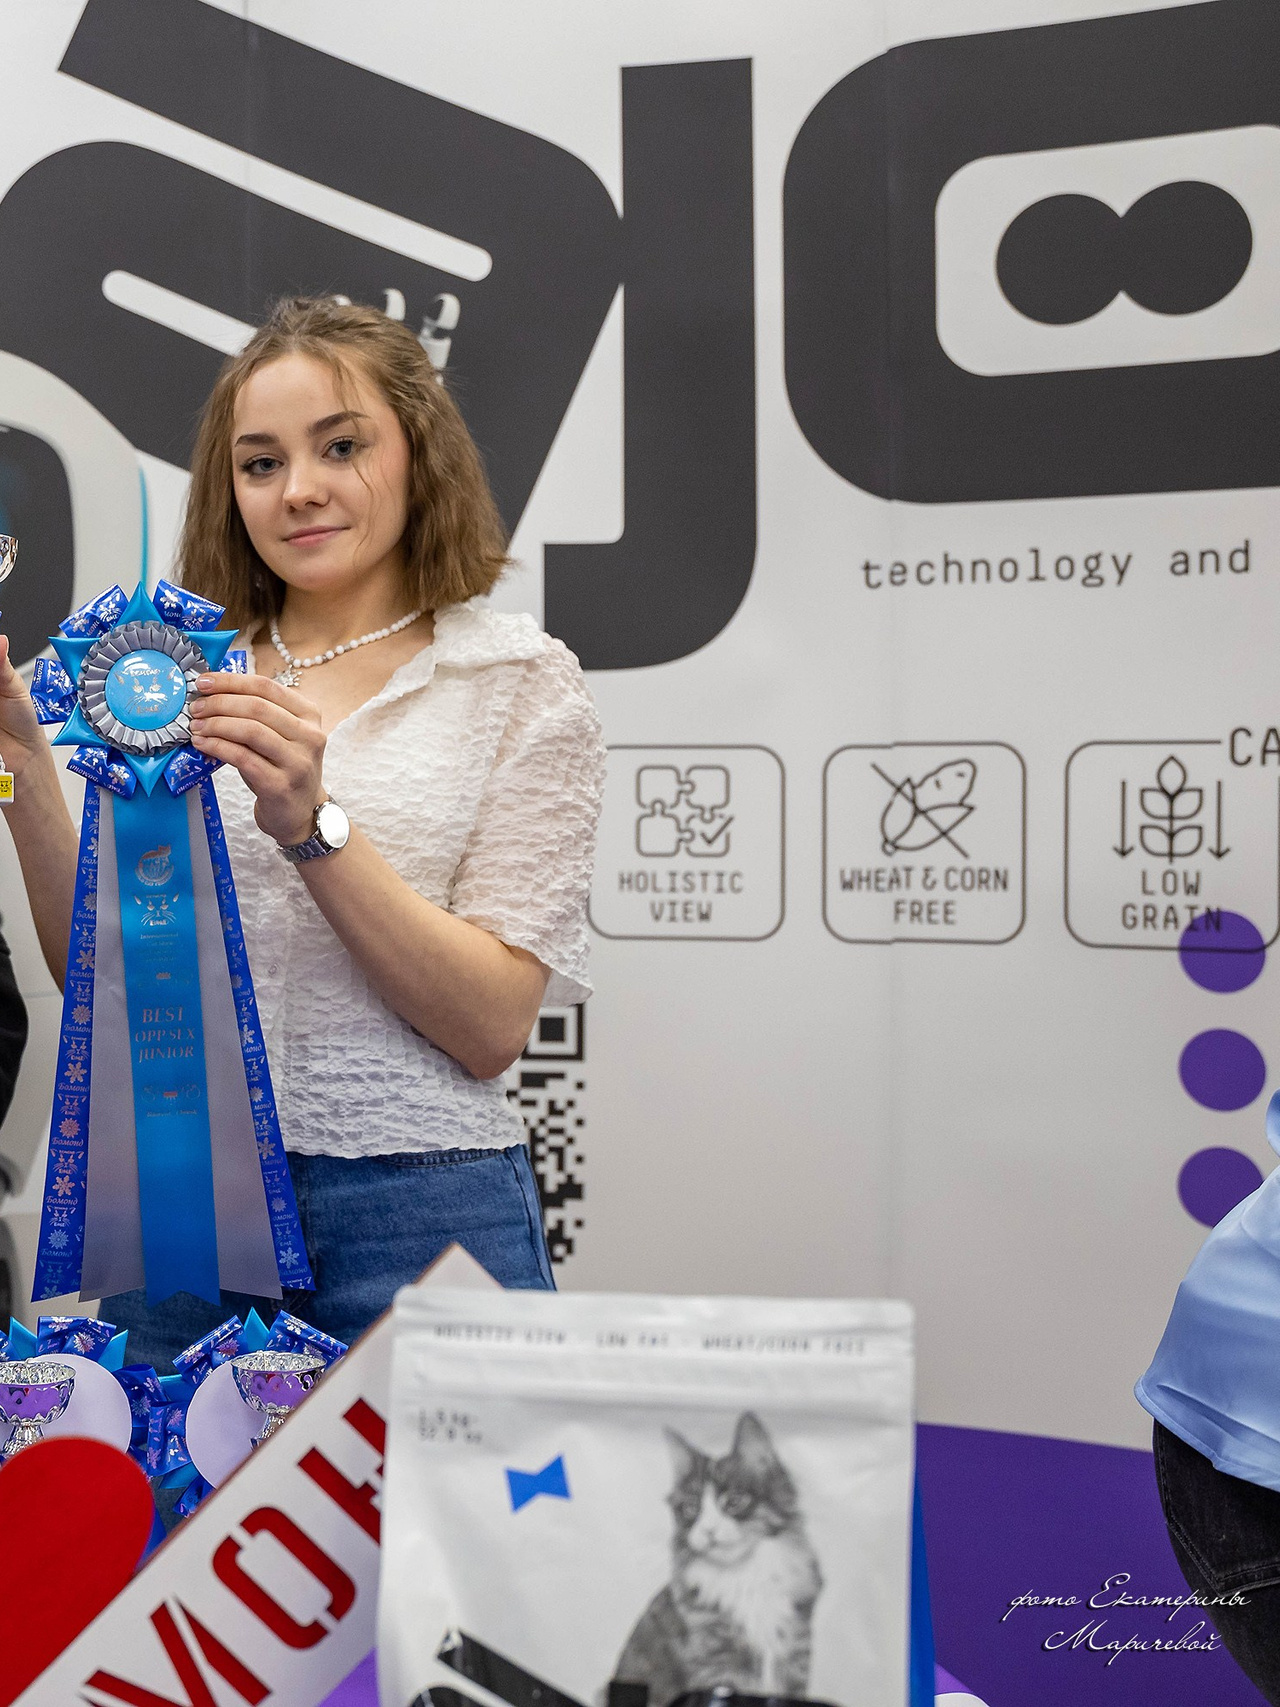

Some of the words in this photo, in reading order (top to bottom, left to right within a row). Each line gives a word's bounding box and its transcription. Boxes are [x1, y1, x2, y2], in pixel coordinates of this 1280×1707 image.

[862, 547, 1133, 589] technology
[1170, 540, 1251, 576] and
[619, 870, 744, 894] HOLISTIC
[839, 866, 915, 893] WHEAT
[922, 866, 939, 891] &
[944, 867, 1010, 892] CORN
[1141, 869, 1202, 897] LOW
[650, 900, 713, 923] VIEW
[894, 899, 957, 925] FREE
[1121, 903, 1221, 932] GRAIN
[142, 1007, 184, 1024] BEST
[135, 1029, 166, 1044] OPP
[138, 1045, 195, 1064] JUNIOR
